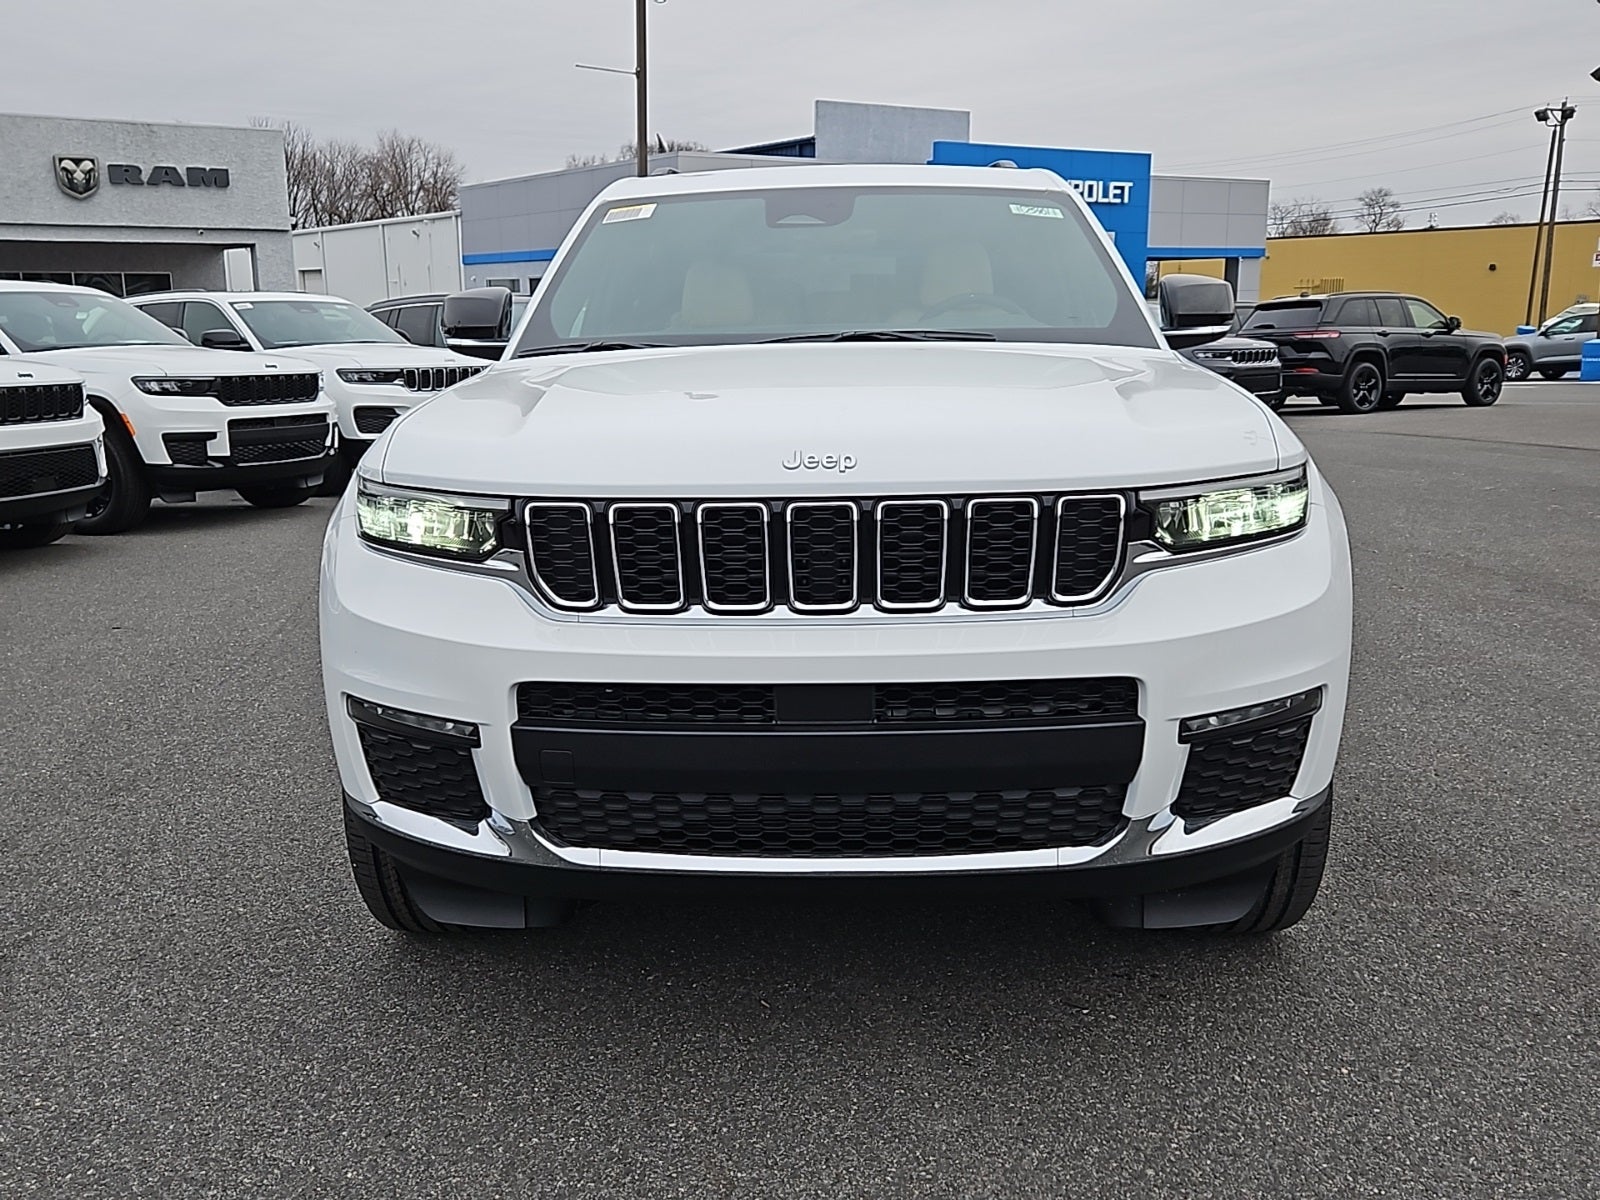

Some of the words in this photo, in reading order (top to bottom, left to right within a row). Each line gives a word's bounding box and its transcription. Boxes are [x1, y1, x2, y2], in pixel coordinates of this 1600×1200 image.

[107, 164, 230, 188] RAM
[1067, 179, 1134, 204] ROLET
[782, 450, 858, 473] Jeep
